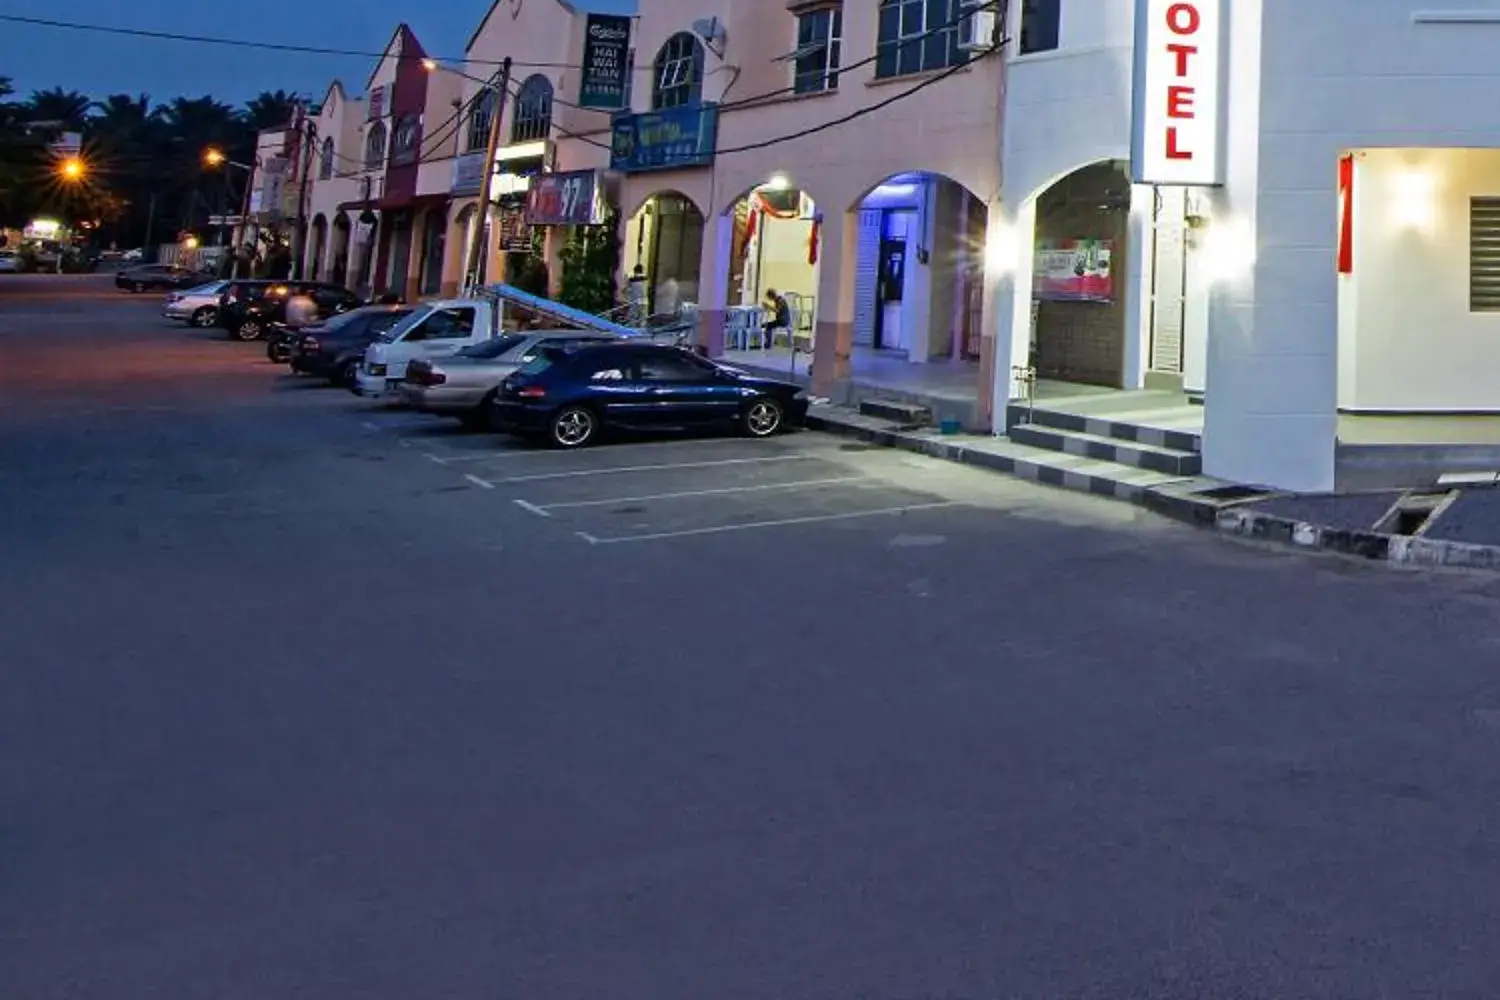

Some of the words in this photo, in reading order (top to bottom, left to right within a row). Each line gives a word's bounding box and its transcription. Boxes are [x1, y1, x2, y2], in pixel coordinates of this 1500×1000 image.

[593, 47, 618, 58] HAI
[592, 58, 618, 68] WAI
[588, 67, 621, 80] TIAN
